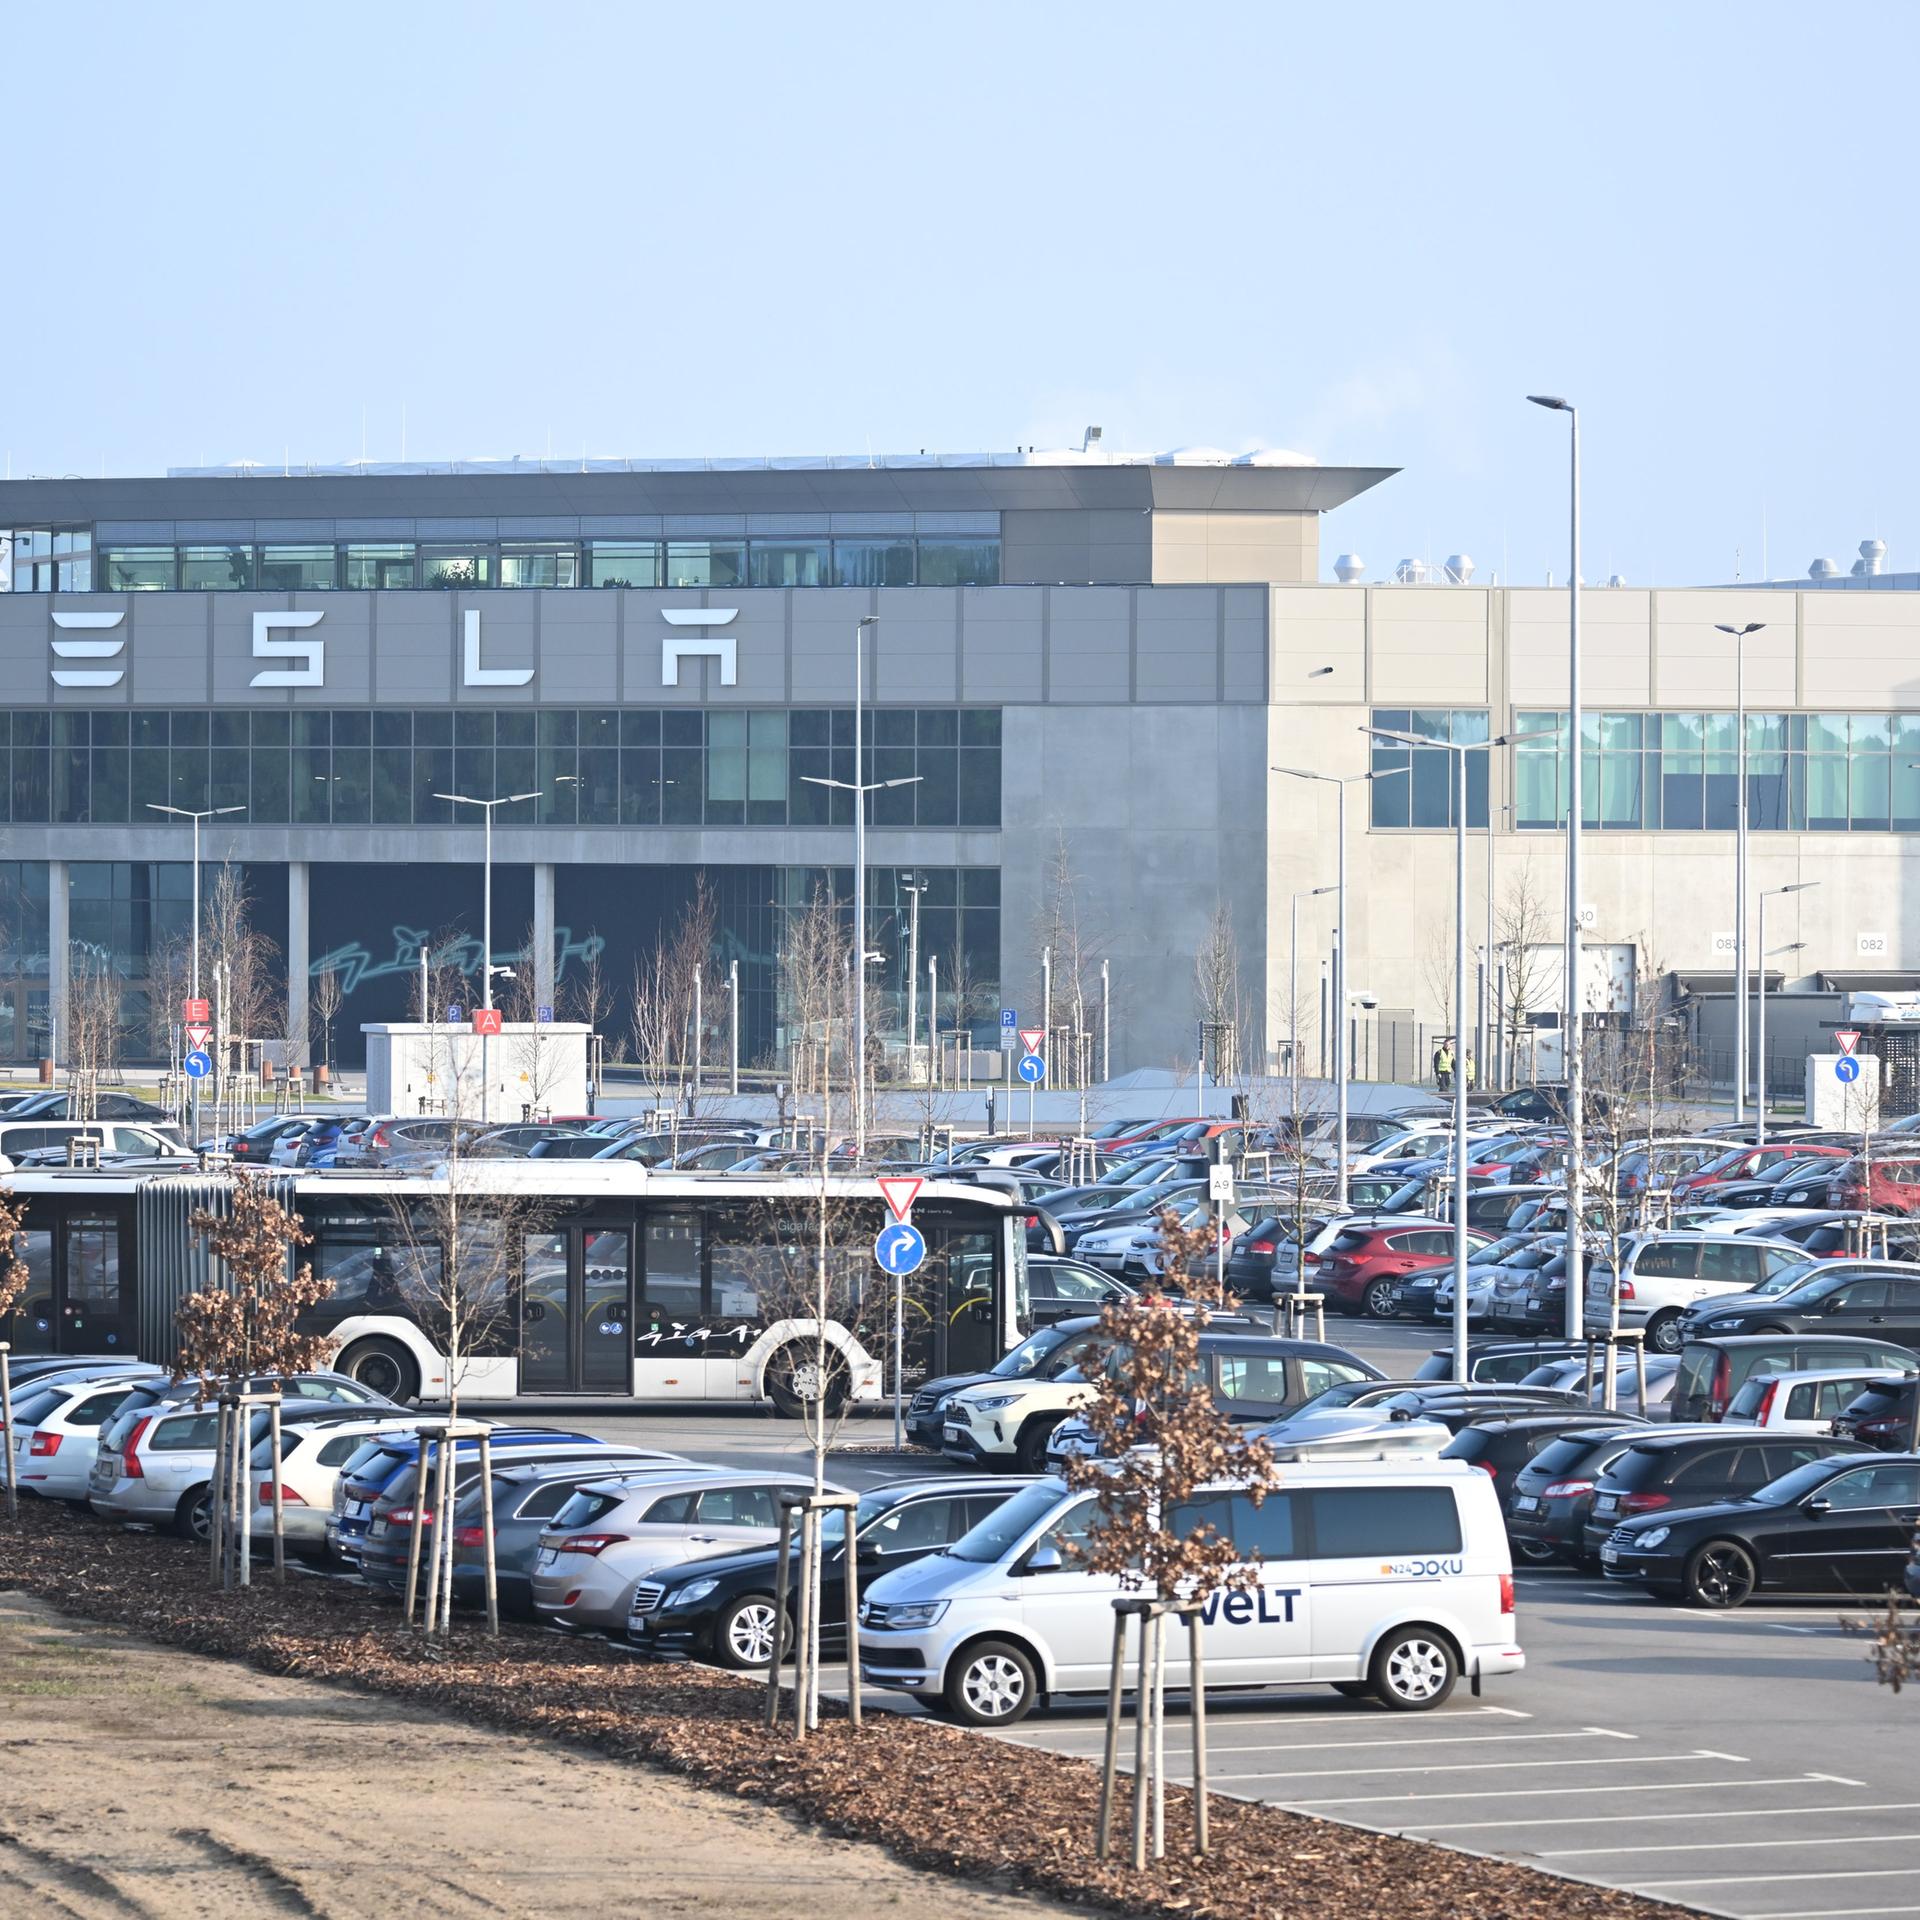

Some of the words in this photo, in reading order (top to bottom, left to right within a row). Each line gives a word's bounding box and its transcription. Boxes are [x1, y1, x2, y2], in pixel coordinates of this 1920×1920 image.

[1860, 938, 1884, 950] 082
[192, 1002, 203, 1017] E
[481, 1013, 497, 1029] A
[1213, 1180, 1230, 1190] A9
[1388, 1564, 1412, 1574] N24
[1412, 1559, 1463, 1576] DOKU
